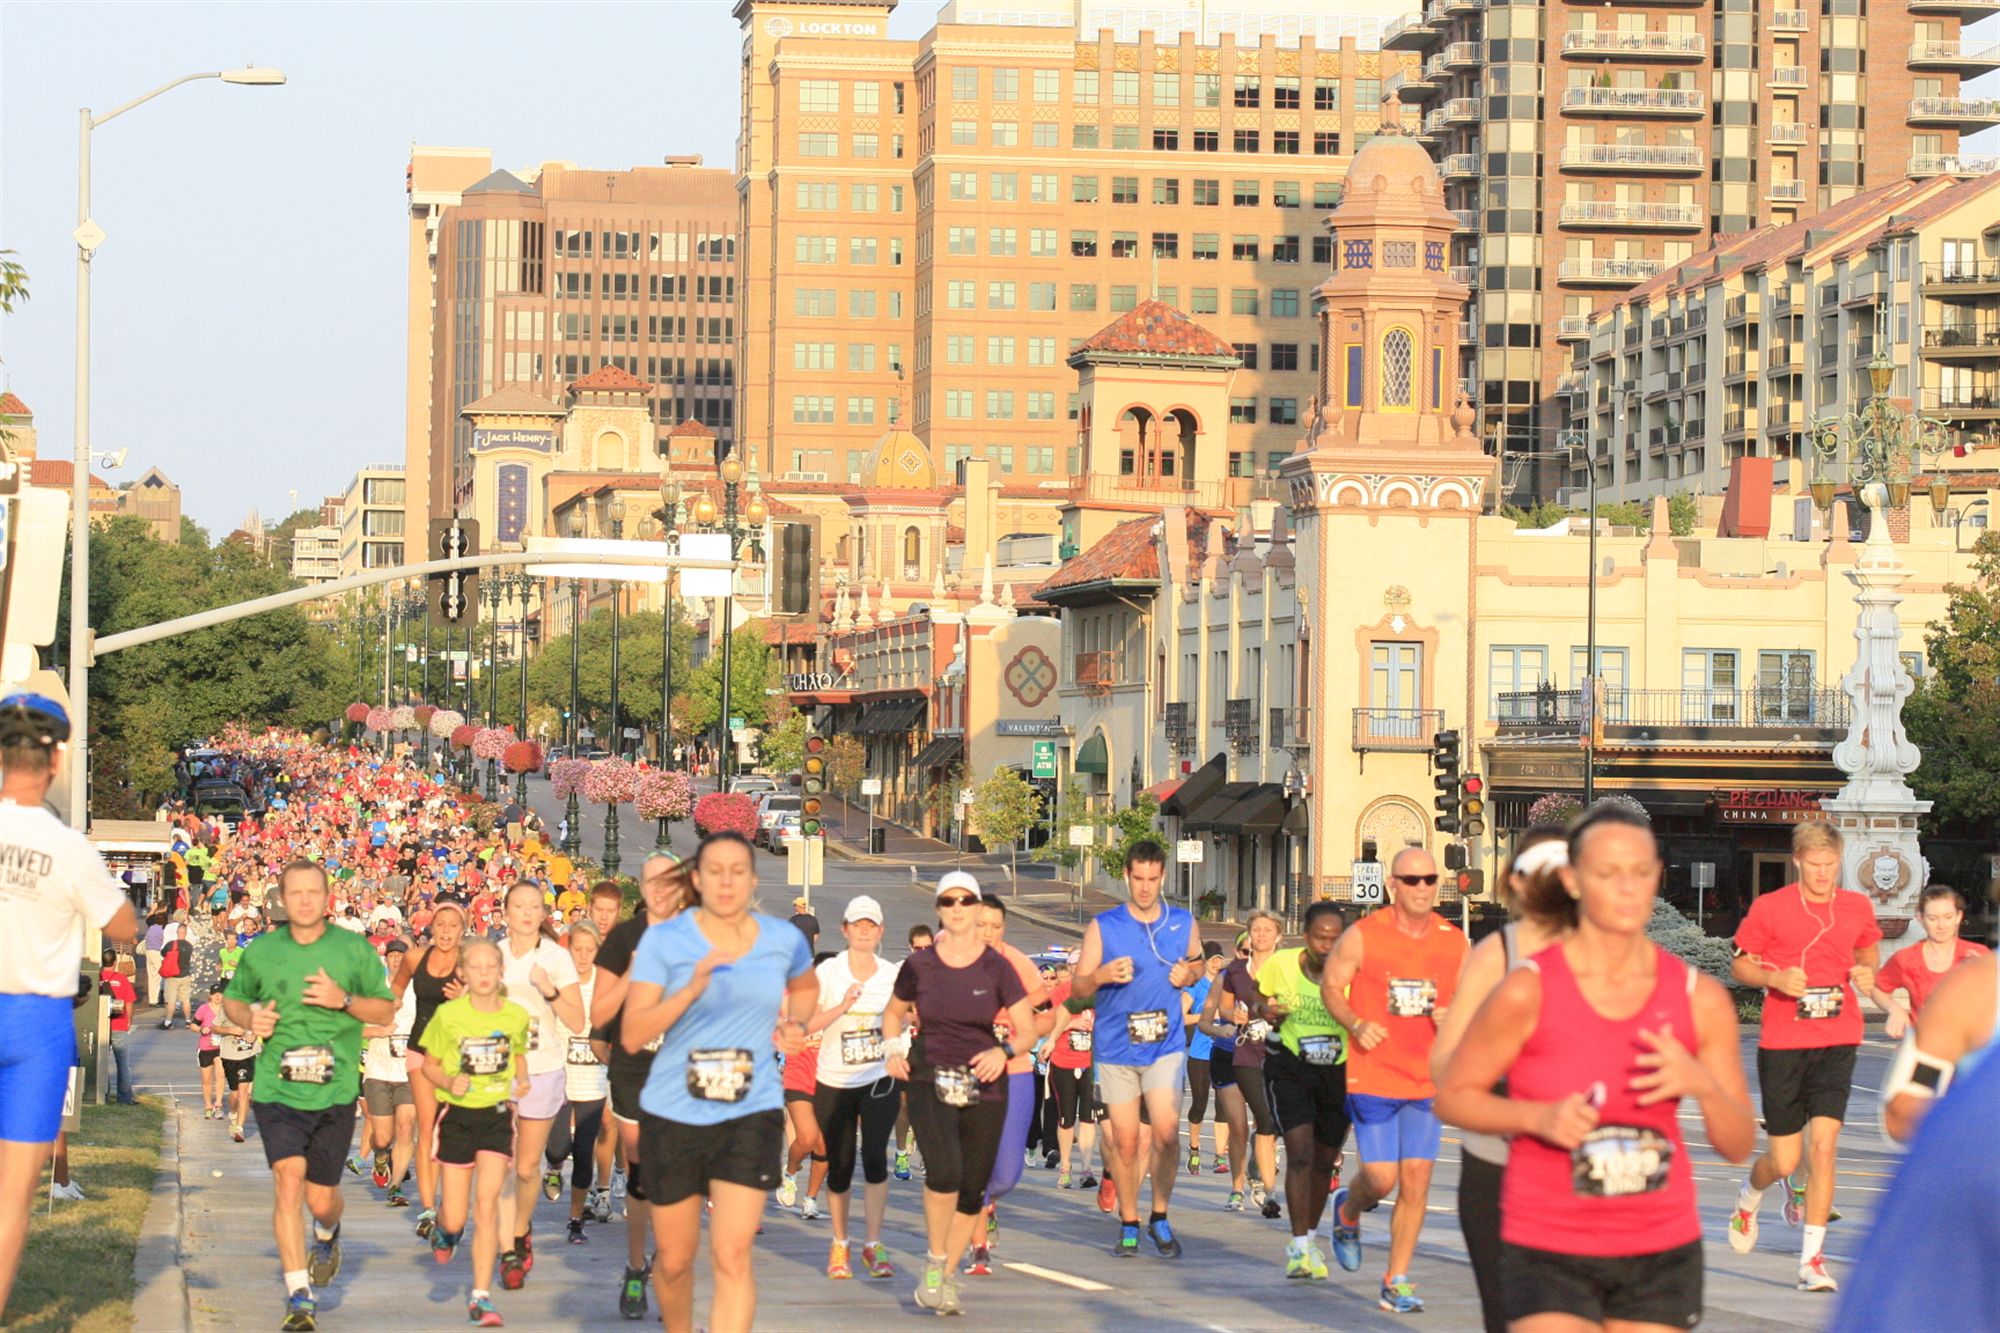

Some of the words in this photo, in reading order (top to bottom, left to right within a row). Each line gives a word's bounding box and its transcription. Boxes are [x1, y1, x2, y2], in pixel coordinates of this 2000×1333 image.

[800, 22, 876, 34] LOCKTON
[481, 430, 511, 447] JACK
[512, 431, 547, 446] HENRY
[1036, 761, 1052, 769] ATM
[1723, 810, 1767, 820] CHINA
[1781, 811, 1833, 821] BISTR
[1356, 866, 1379, 874] SPEED
[1356, 883, 1380, 899] 30
[469, 1053, 503, 1066] 1531
[843, 1045, 881, 1061] 3648
[1305, 1048, 1337, 1060] 2079
[291, 1064, 326, 1077] 1532
[696, 1071, 745, 1089] 1729
